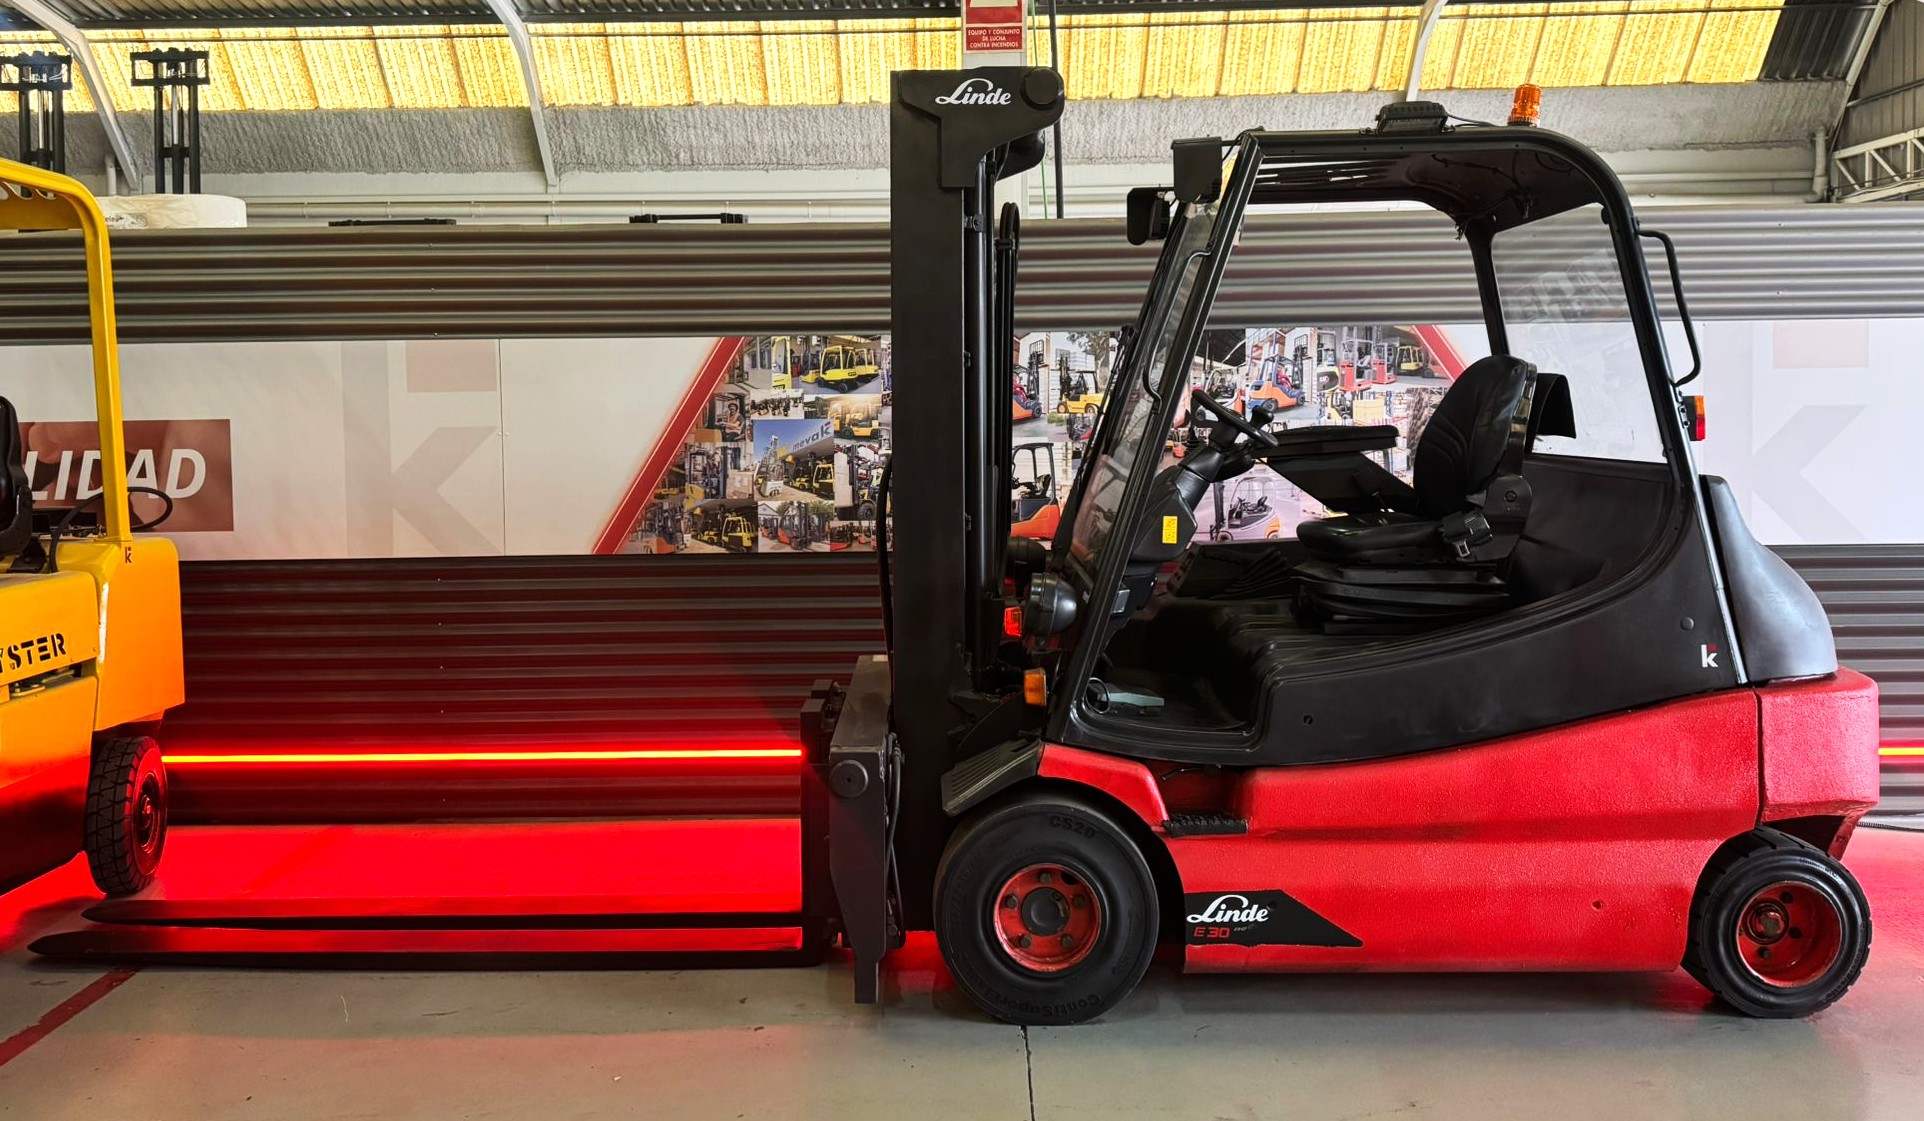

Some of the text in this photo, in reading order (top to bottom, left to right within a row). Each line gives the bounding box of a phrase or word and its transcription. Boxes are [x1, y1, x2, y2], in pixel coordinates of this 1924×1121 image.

[934, 78, 1012, 105] Linde
[0, 633, 66, 673] STER
[1701, 644, 1718, 668] k
[1186, 894, 1269, 923] Linde
